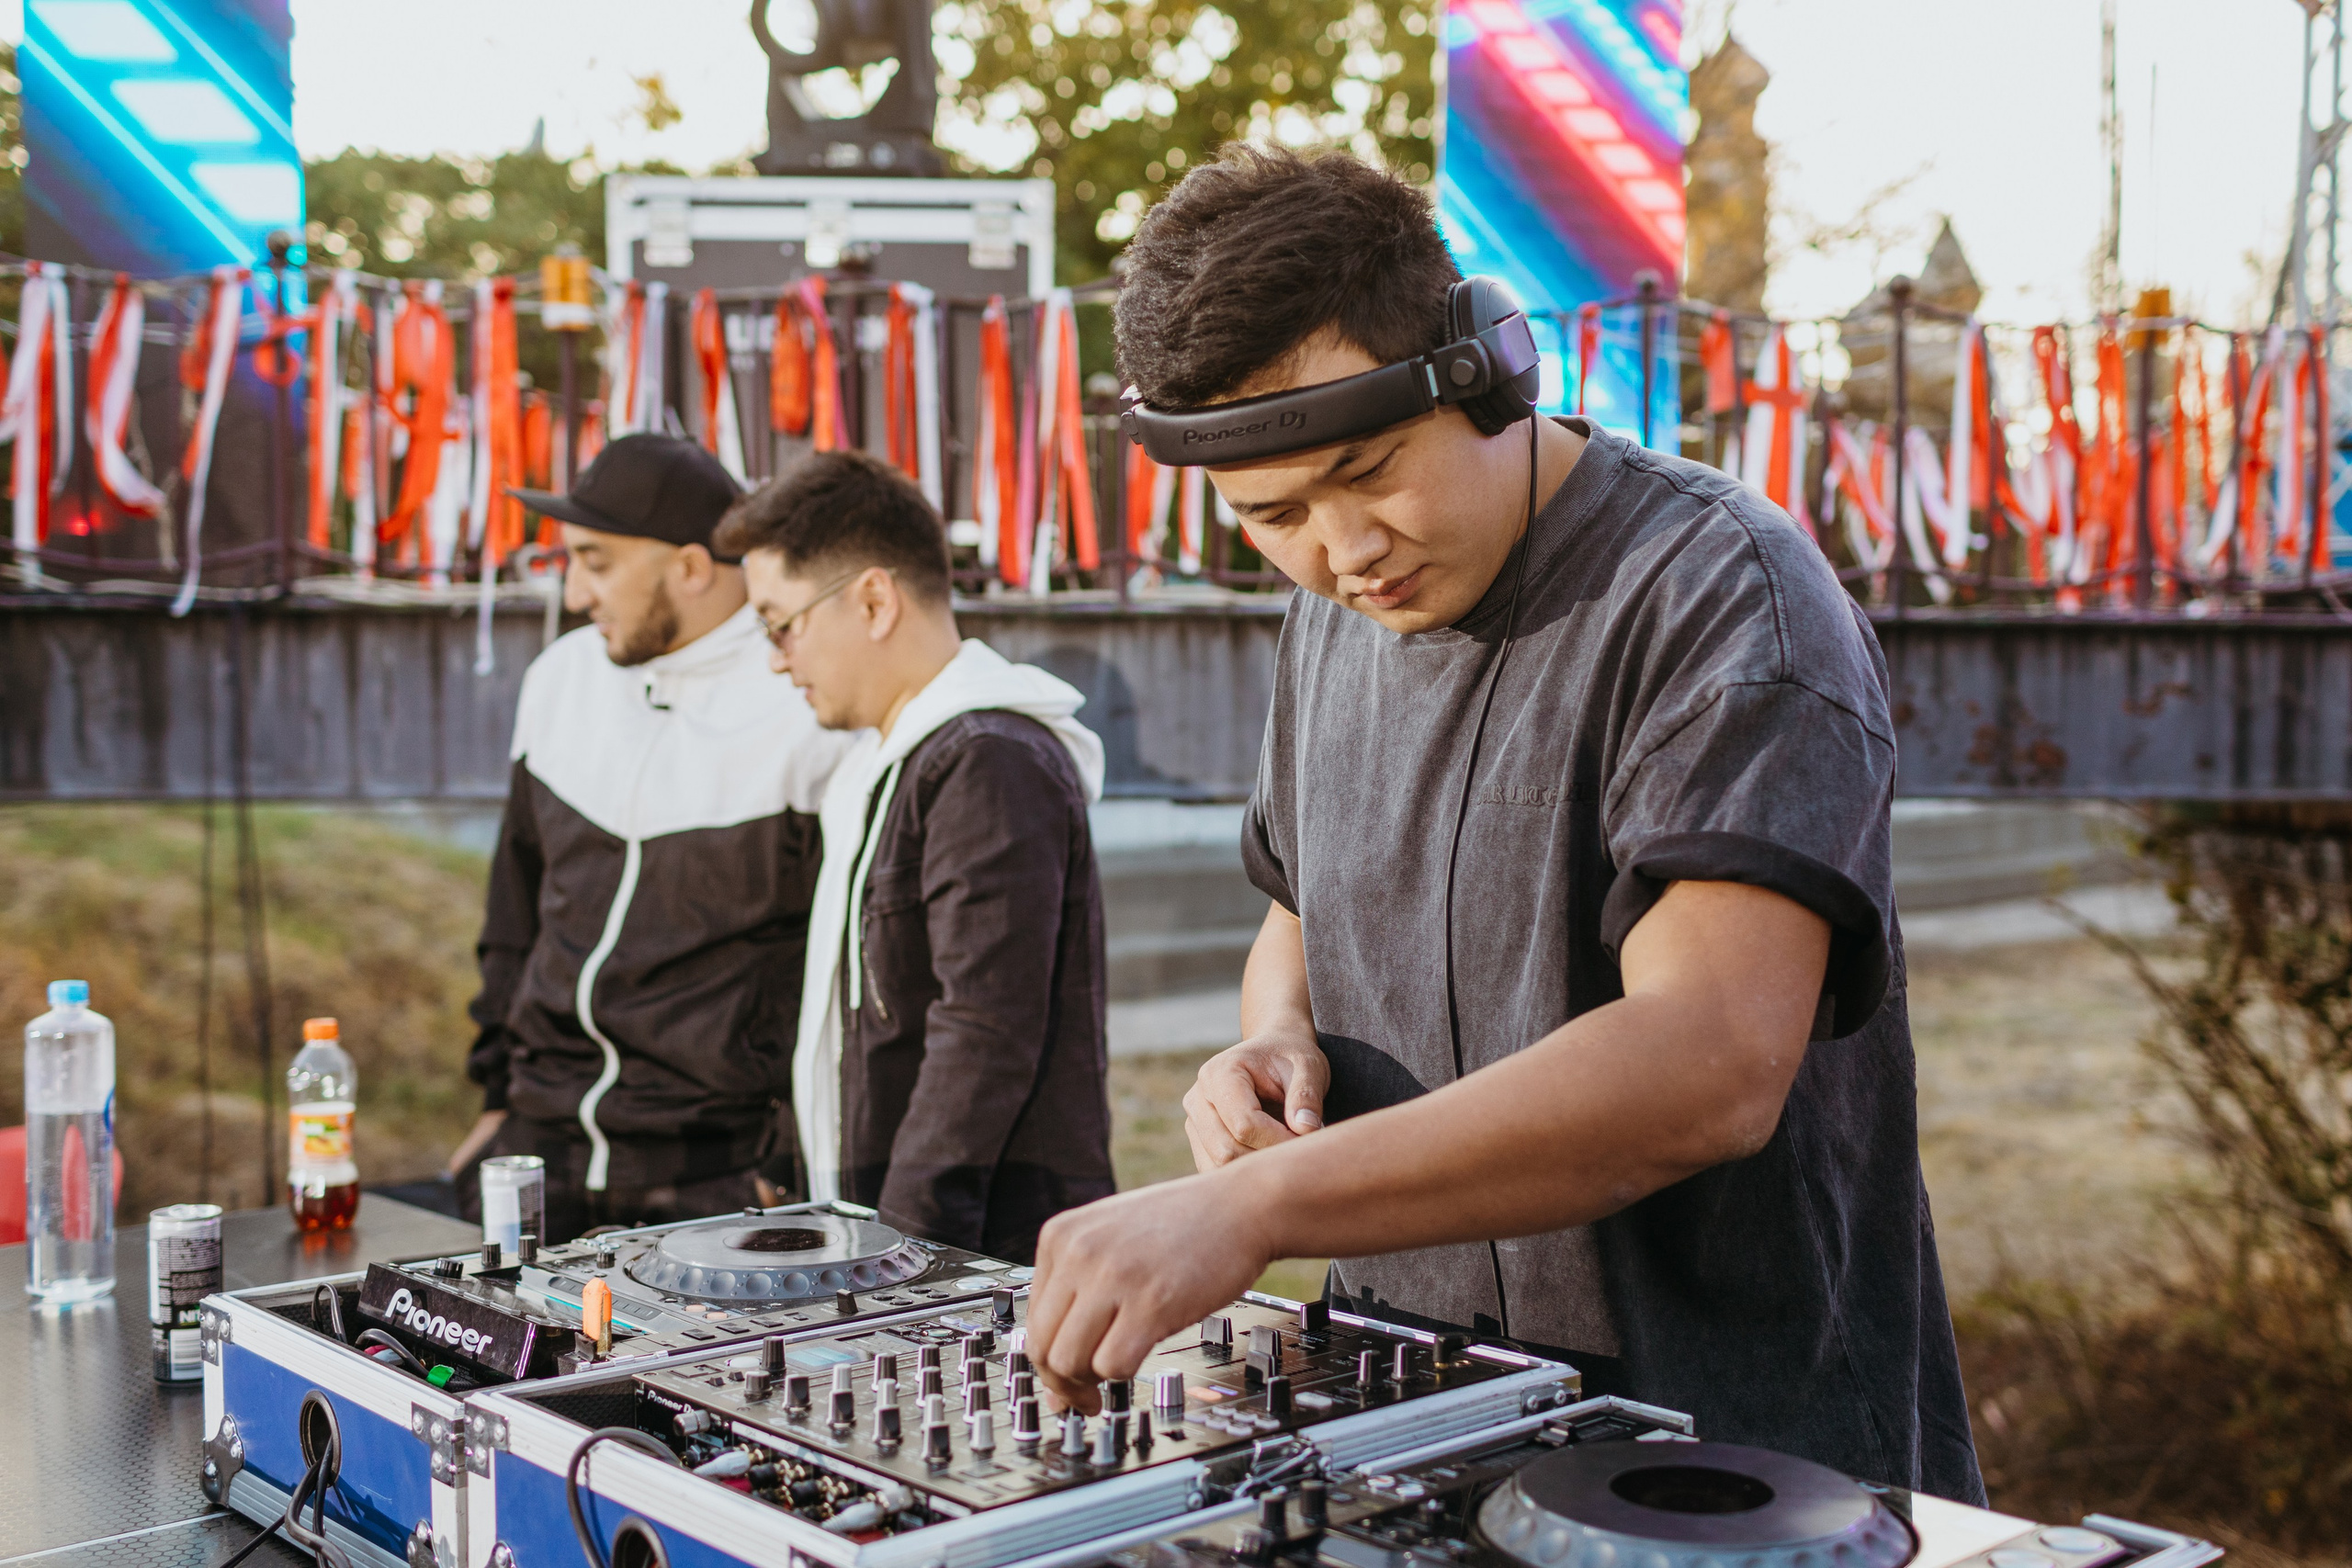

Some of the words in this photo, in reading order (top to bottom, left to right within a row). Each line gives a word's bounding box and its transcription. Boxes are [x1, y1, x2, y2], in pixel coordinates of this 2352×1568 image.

[1182, 420, 1272, 446] Pioneer
[1278, 410, 1307, 431] DJ
[384, 1288, 493, 1355] Pioneer
[647, 1389, 683, 1411] Pioneer
